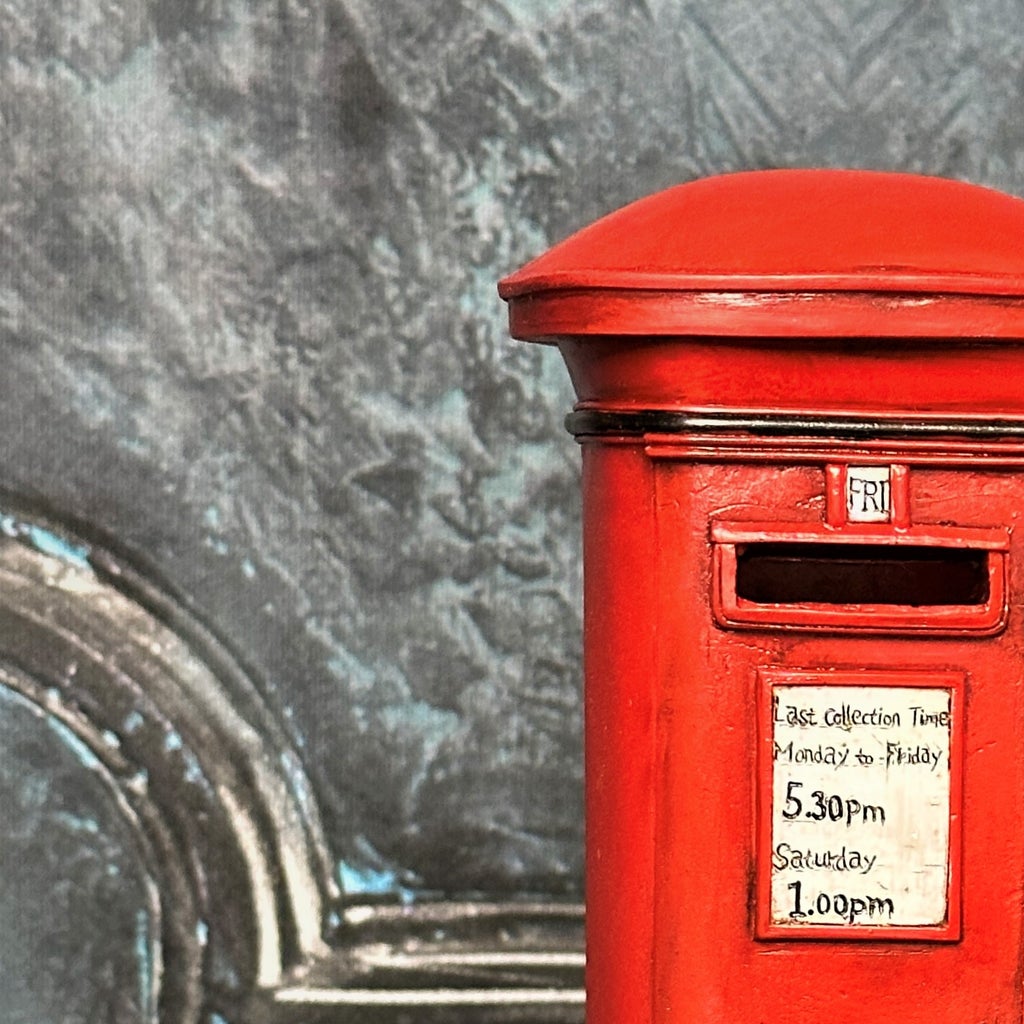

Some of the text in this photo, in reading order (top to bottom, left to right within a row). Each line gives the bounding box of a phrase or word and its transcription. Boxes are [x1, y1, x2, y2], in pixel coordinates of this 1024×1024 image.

[849, 476, 889, 513] FRI
[774, 696, 818, 728] Last
[774, 740, 943, 772] Monday to Friday
[782, 781, 886, 827] 5.30pm
[774, 842, 877, 875] Saturday
[787, 880, 895, 922] 1.00pm
